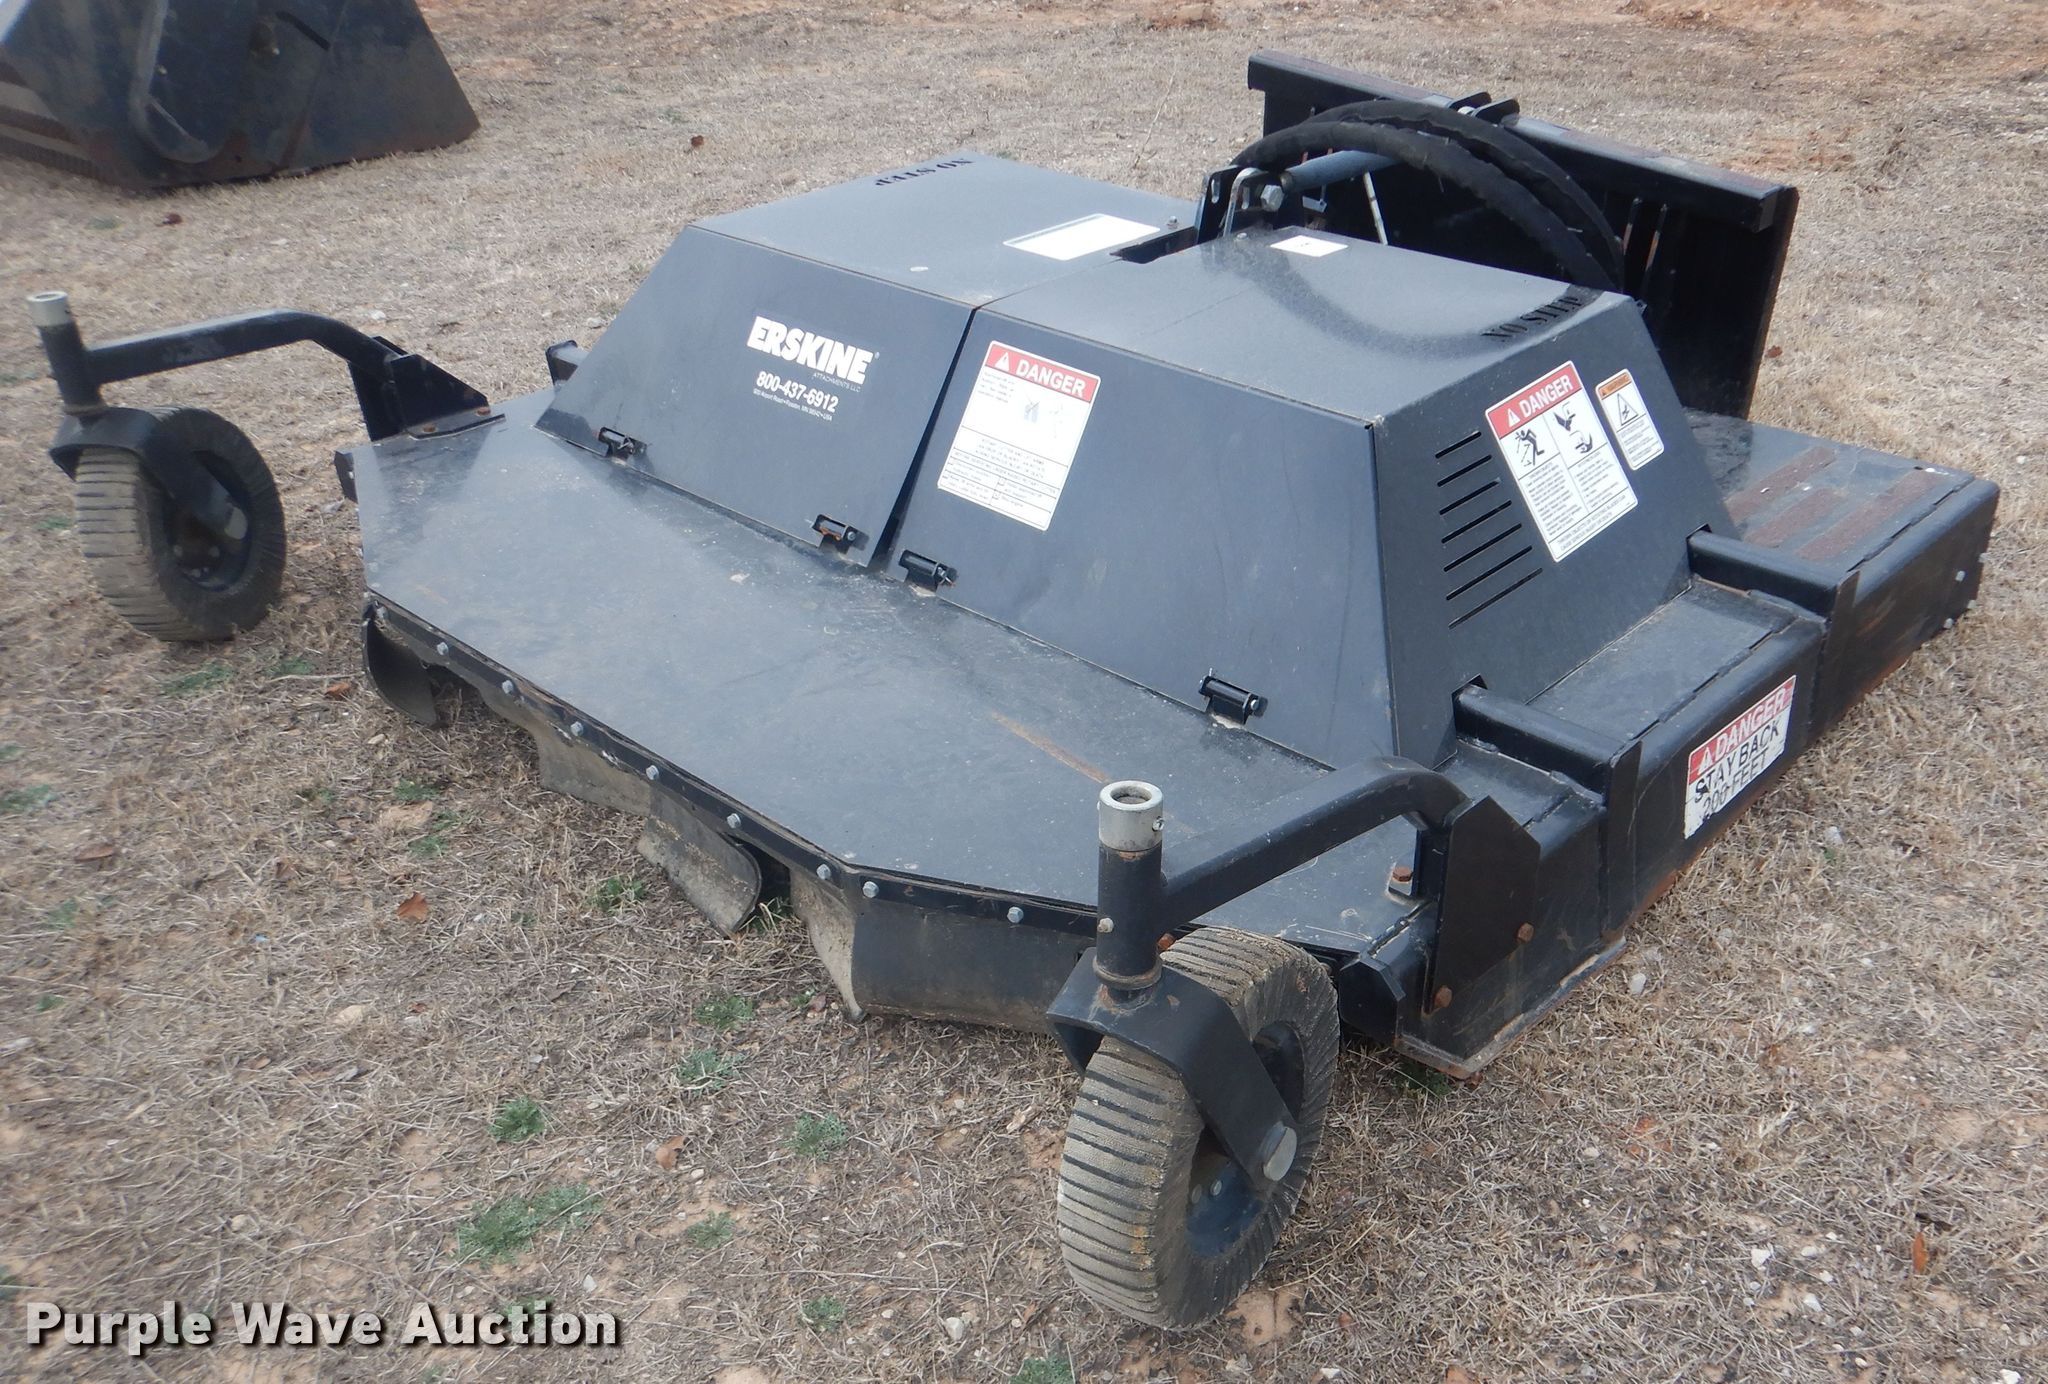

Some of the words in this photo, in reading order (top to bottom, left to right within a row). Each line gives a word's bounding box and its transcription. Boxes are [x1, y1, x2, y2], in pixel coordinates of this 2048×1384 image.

[747, 316, 874, 385] ERSKINE
[756, 370, 839, 413] 800-437-6912
[1015, 359, 1087, 398] DANGER
[1518, 373, 1574, 419] DANGER
[1714, 687, 1787, 760] DANGER
[1694, 750, 1737, 804] STAY
[1738, 719, 1780, 768] BACK
[1731, 747, 1769, 794] FEET
